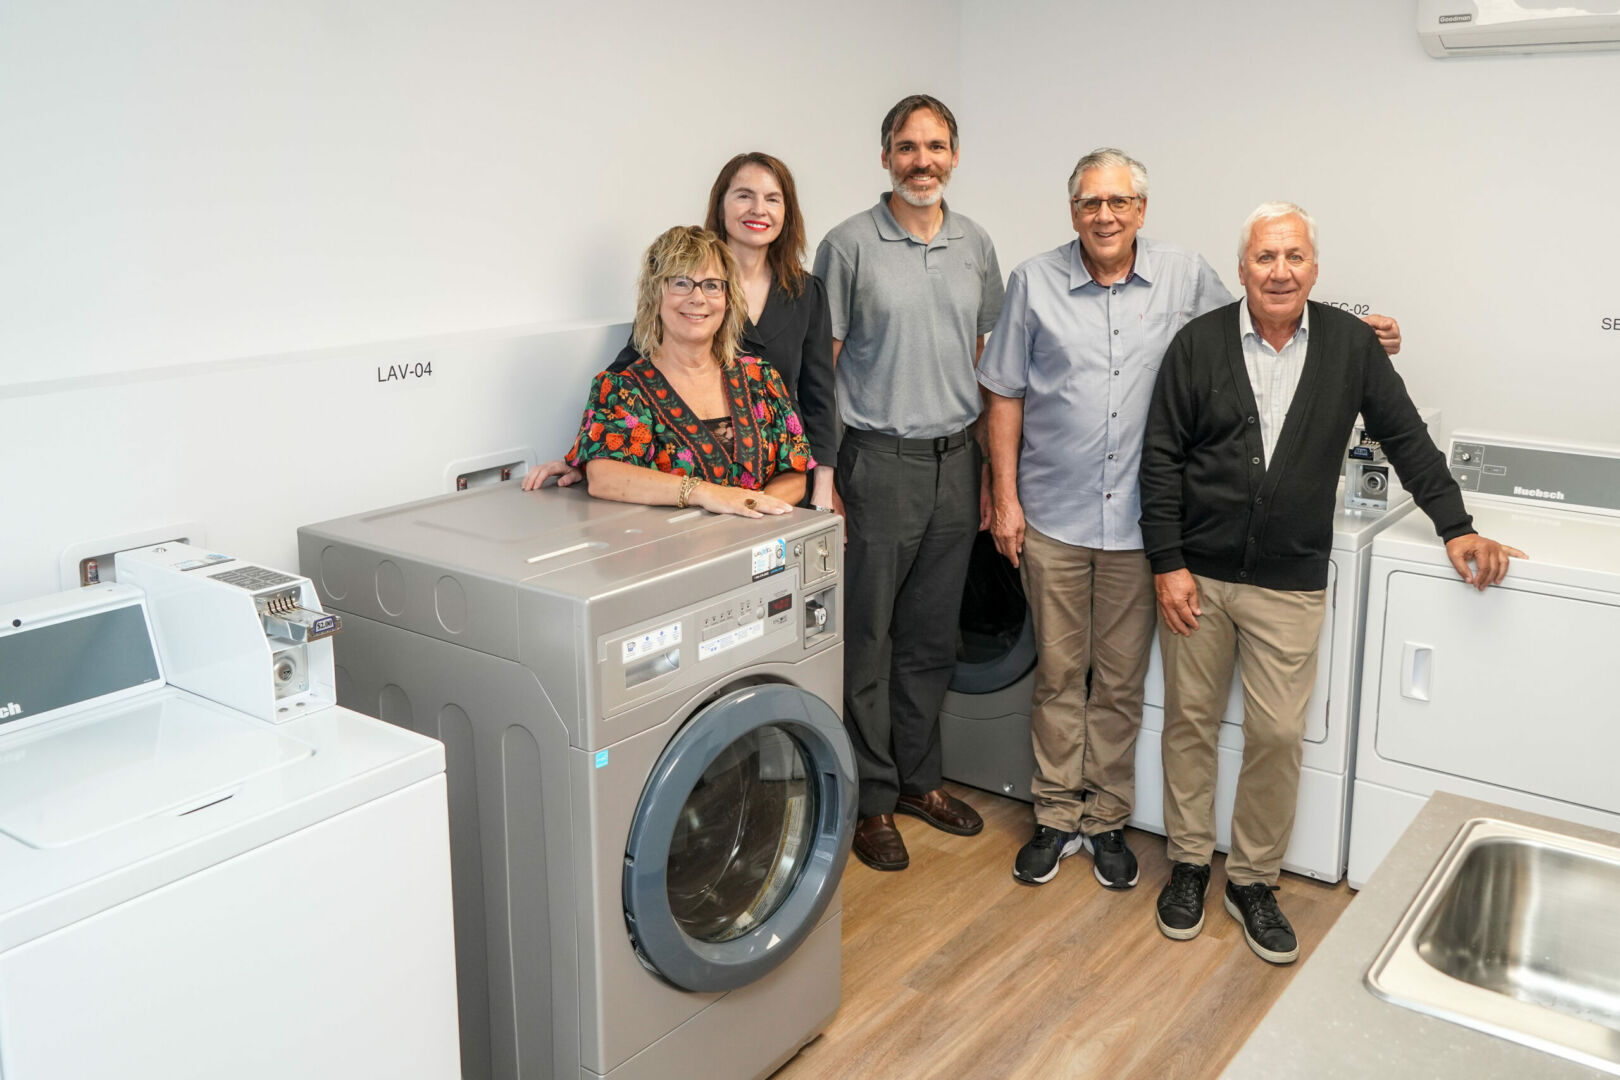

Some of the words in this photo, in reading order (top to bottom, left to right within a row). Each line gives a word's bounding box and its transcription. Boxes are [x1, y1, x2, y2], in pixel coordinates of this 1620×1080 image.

[1440, 15, 1471, 23] Goodman
[377, 361, 433, 382] LAV-04
[1513, 487, 1565, 500] Huebsch
[317, 620, 333, 630] $2.00
